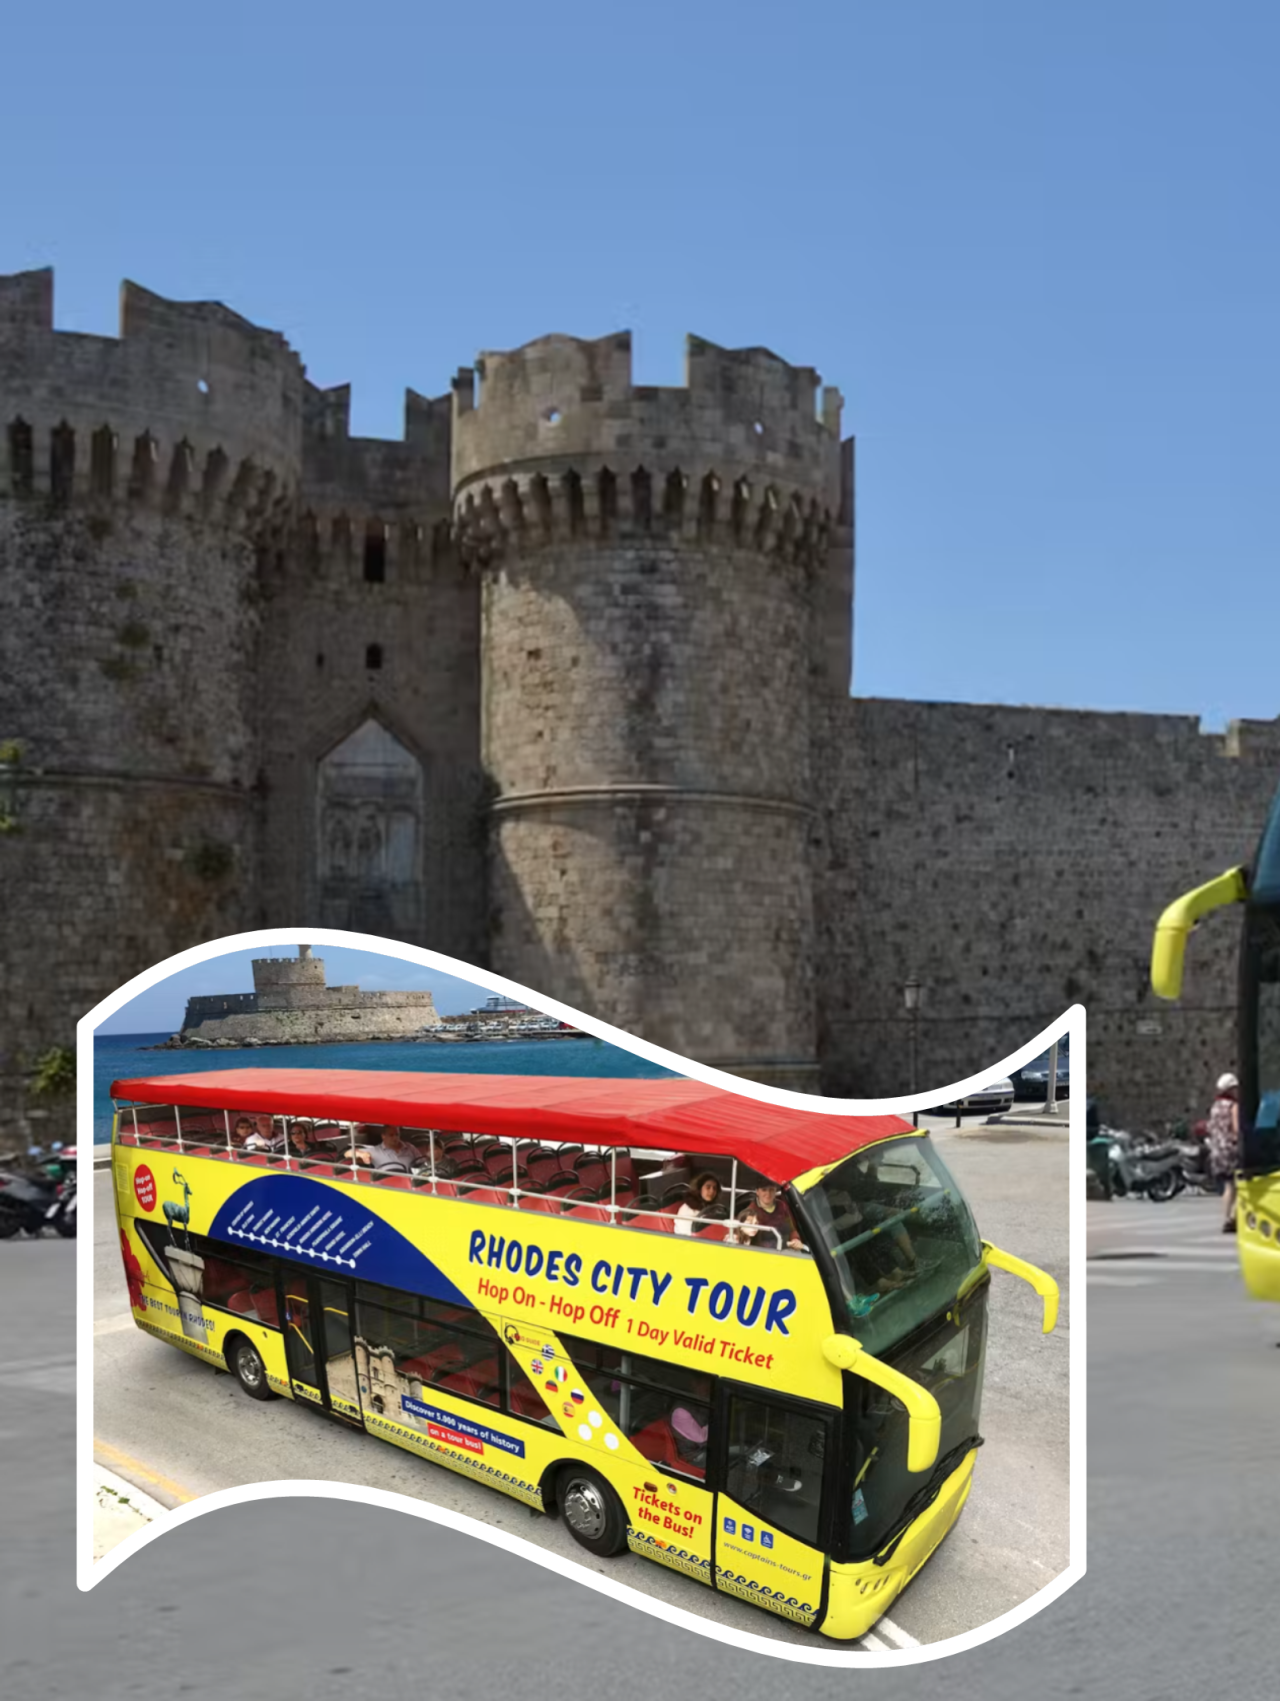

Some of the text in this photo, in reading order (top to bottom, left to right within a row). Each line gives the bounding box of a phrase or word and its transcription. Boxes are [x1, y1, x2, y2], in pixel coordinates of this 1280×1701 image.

[468, 1229, 797, 1336] RHODES CITY TOUR
[477, 1277, 509, 1304] Hop
[513, 1286, 536, 1308] On
[549, 1294, 585, 1324] Hop
[589, 1305, 621, 1328] Off
[626, 1318, 633, 1334] 1
[637, 1321, 669, 1346] Day
[673, 1329, 716, 1355] Valid
[719, 1340, 775, 1370] Ticket
[404, 1400, 520, 1454] Discover 5.000 years of history
[429, 1428, 439, 1437] on
[447, 1432, 463, 1444] tour
[632, 1486, 703, 1525] Tickets on
[638, 1506, 694, 1539] the Bus!
[723, 1541, 812, 1581] www.captains-tours.gr
